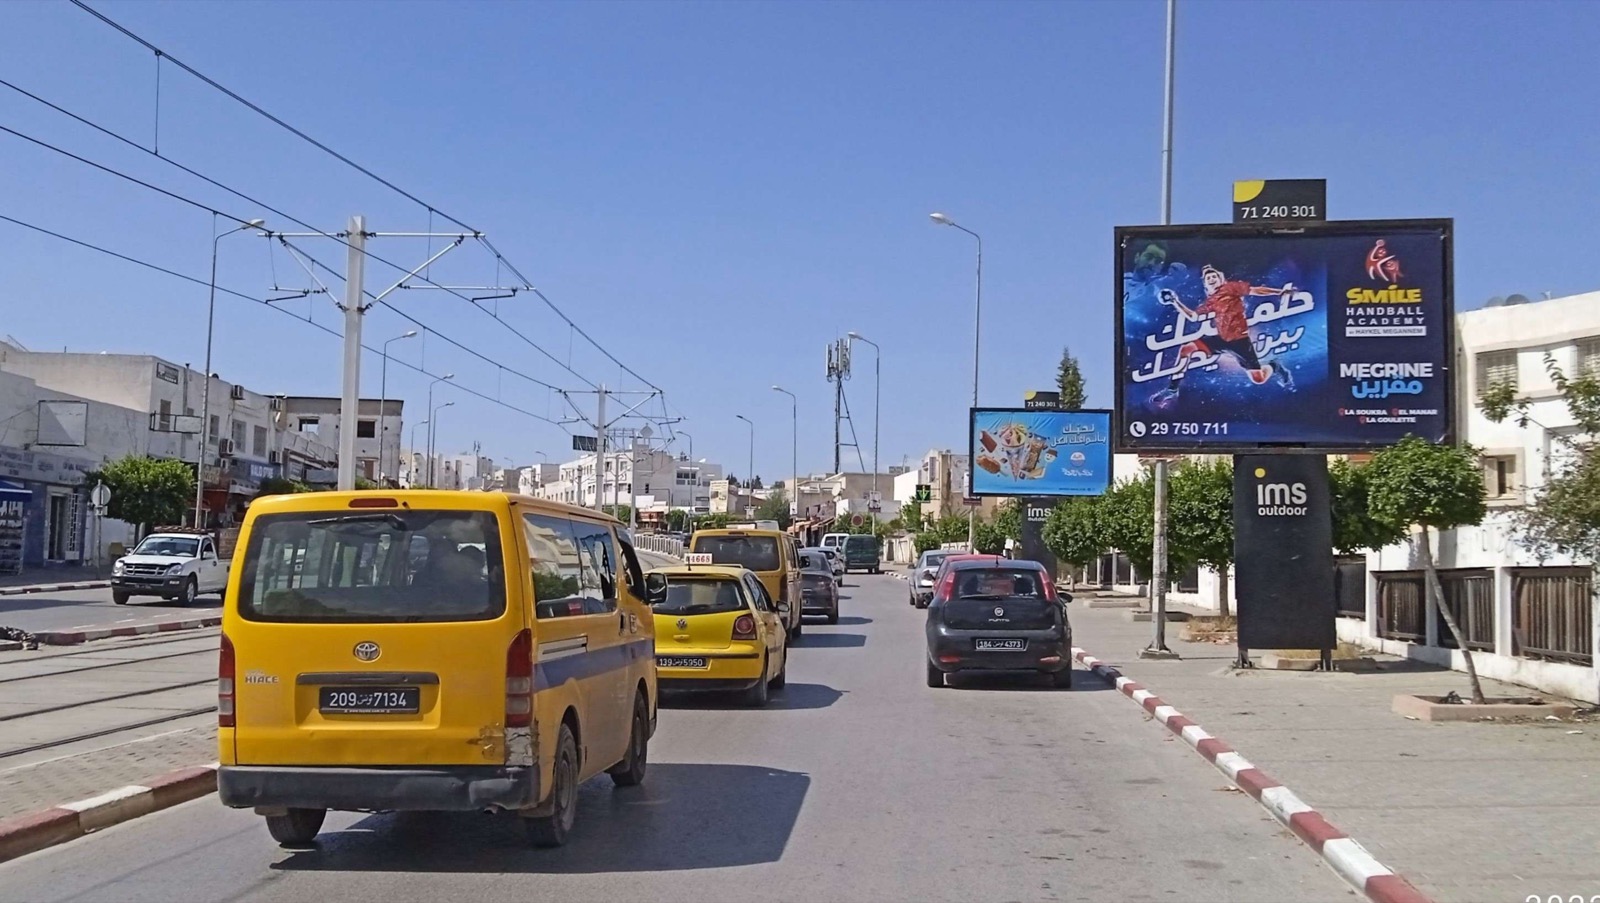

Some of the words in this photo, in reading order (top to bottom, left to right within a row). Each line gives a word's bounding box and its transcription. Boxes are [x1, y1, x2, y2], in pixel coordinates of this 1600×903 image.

[1241, 206, 1258, 218] 71
[1262, 206, 1288, 218] 240
[1291, 205, 1317, 217] 301
[1346, 306, 1424, 316] HANDBALL
[1346, 317, 1425, 325] ACADEMY
[1253, 326, 1305, 359] بين
[1131, 350, 1222, 383] يديك
[1340, 362, 1433, 378] MEGRINE
[1151, 423, 1168, 435] 29
[1173, 423, 1199, 435] 750
[1202, 422, 1228, 434] 711
[1254, 468, 1307, 505] ims
[1027, 503, 1052, 517] ims
[1258, 505, 1307, 516] outdoor
[659, 658, 672, 666] 139
[245, 675, 278, 683] HIACE
[329, 692, 357, 707] 209
[357, 694, 373, 706] تونس
[373, 692, 407, 707] 7134
